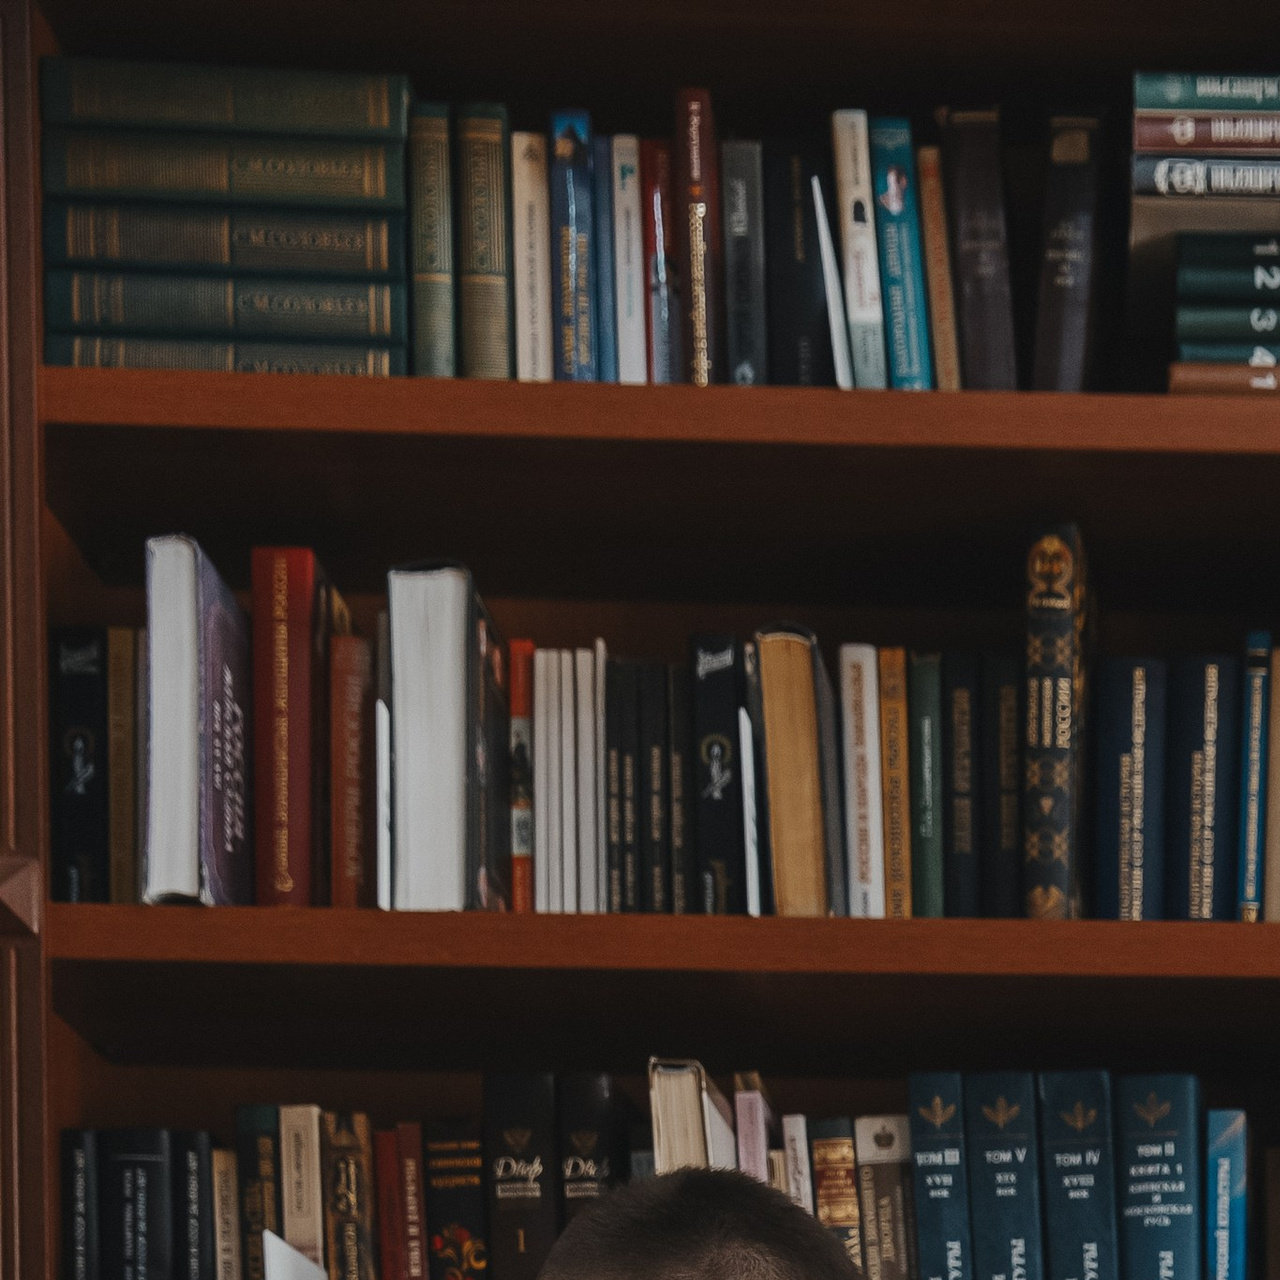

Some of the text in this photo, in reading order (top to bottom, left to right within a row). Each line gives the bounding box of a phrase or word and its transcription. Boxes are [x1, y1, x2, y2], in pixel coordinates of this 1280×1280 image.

[1251, 240, 1279, 257] 1
[1249, 309, 1279, 331] 3
[1249, 373, 1279, 391] 1
[1055, 677, 1071, 748] РОССИИ
[915, 1151, 942, 1166] ТОМ
[986, 1151, 1012, 1163] ТОМ
[1137, 1145, 1162, 1157] ТОМ
[1055, 1153, 1082, 1167] ТОМ
